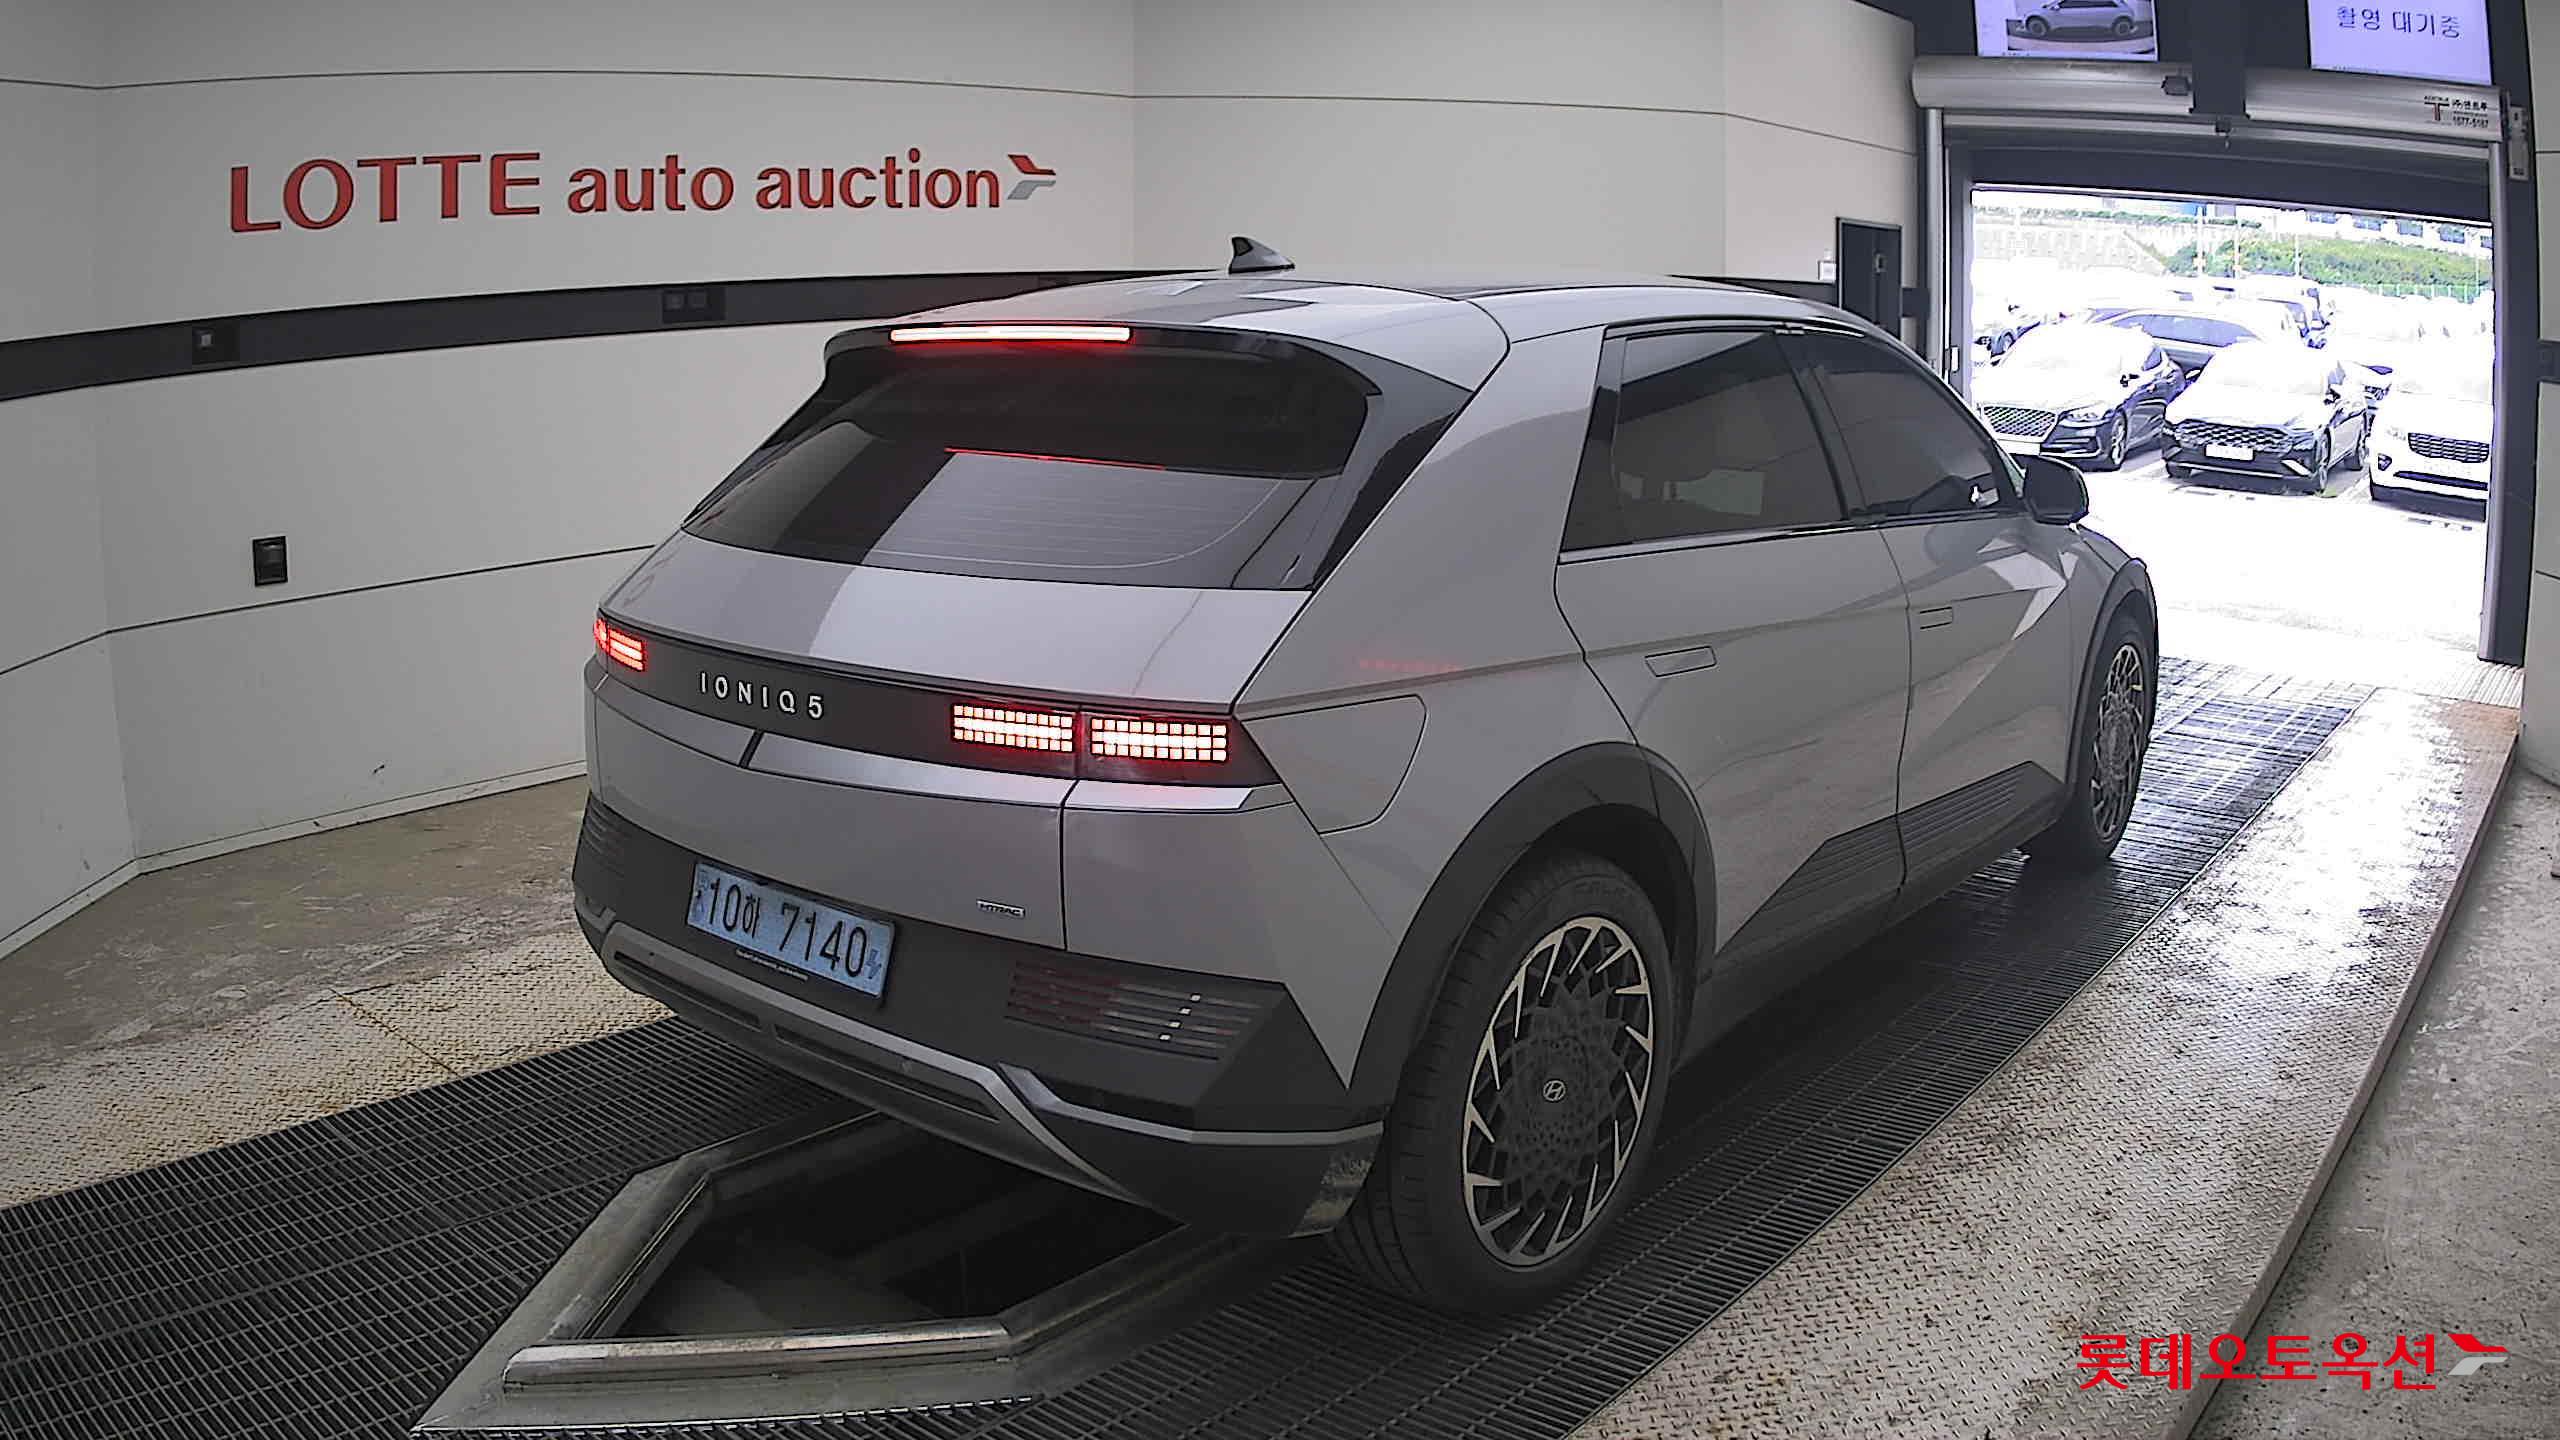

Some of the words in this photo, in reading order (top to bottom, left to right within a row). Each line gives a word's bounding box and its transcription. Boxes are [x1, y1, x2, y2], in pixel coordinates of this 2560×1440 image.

[2337, 6, 2380, 30] 촬영
[2392, 11, 2460, 38] 대기중
[230, 152, 541, 232] LOTTE
[567, 154, 735, 214] auto
[756, 147, 1001, 210] auction
[701, 672, 796, 714] IONIQ
[808, 694, 823, 719] 5
[710, 877, 760, 939] 10하
[780, 902, 868, 978] 7140
